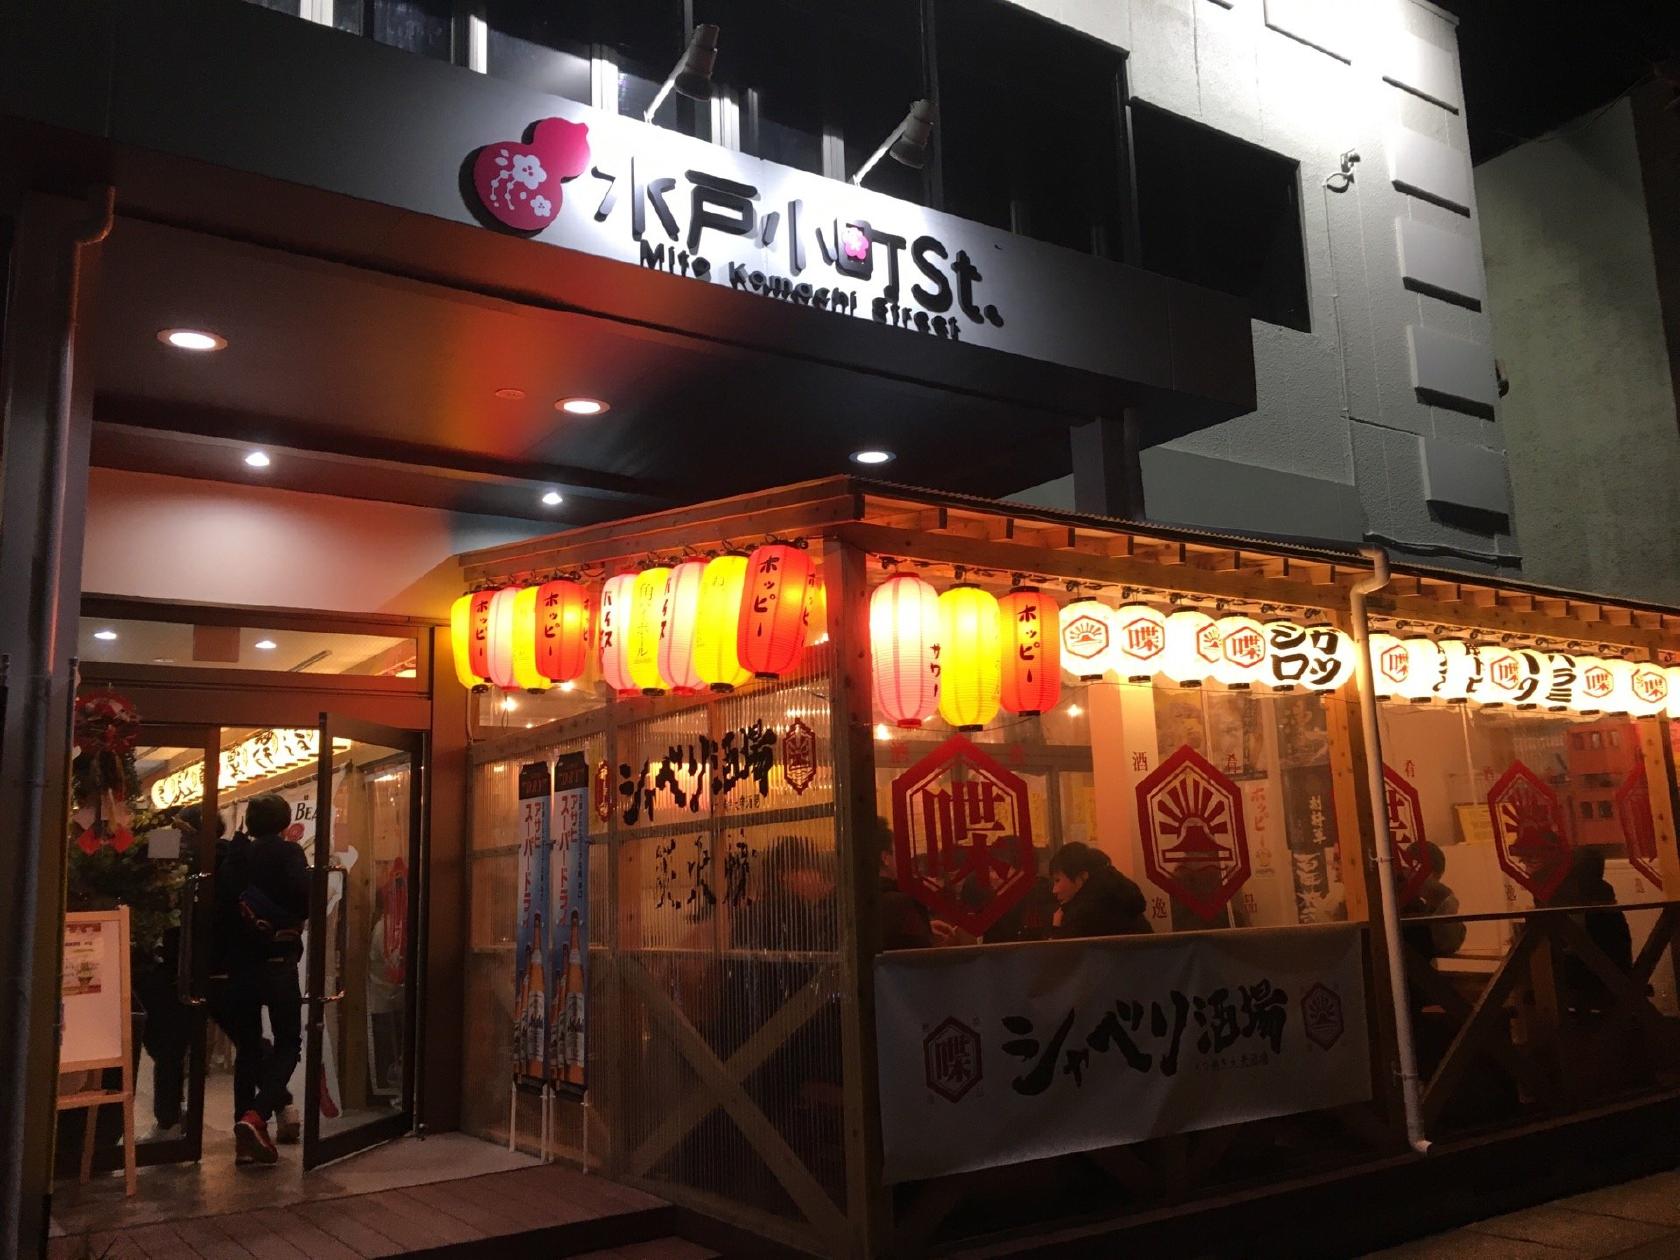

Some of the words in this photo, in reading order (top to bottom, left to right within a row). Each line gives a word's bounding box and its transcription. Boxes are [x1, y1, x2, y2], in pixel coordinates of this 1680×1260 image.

[640, 239, 711, 281] Mito
[728, 261, 858, 317] Komachi
[544, 592, 560, 657] ホッピー
[754, 555, 781, 637] ホッピー
[1017, 604, 1041, 683] ホッピー
[534, 802, 542, 848] アサヒ
[570, 795, 578, 843] アサヒ
[1001, 978, 1289, 1095] シャベリ酒場
